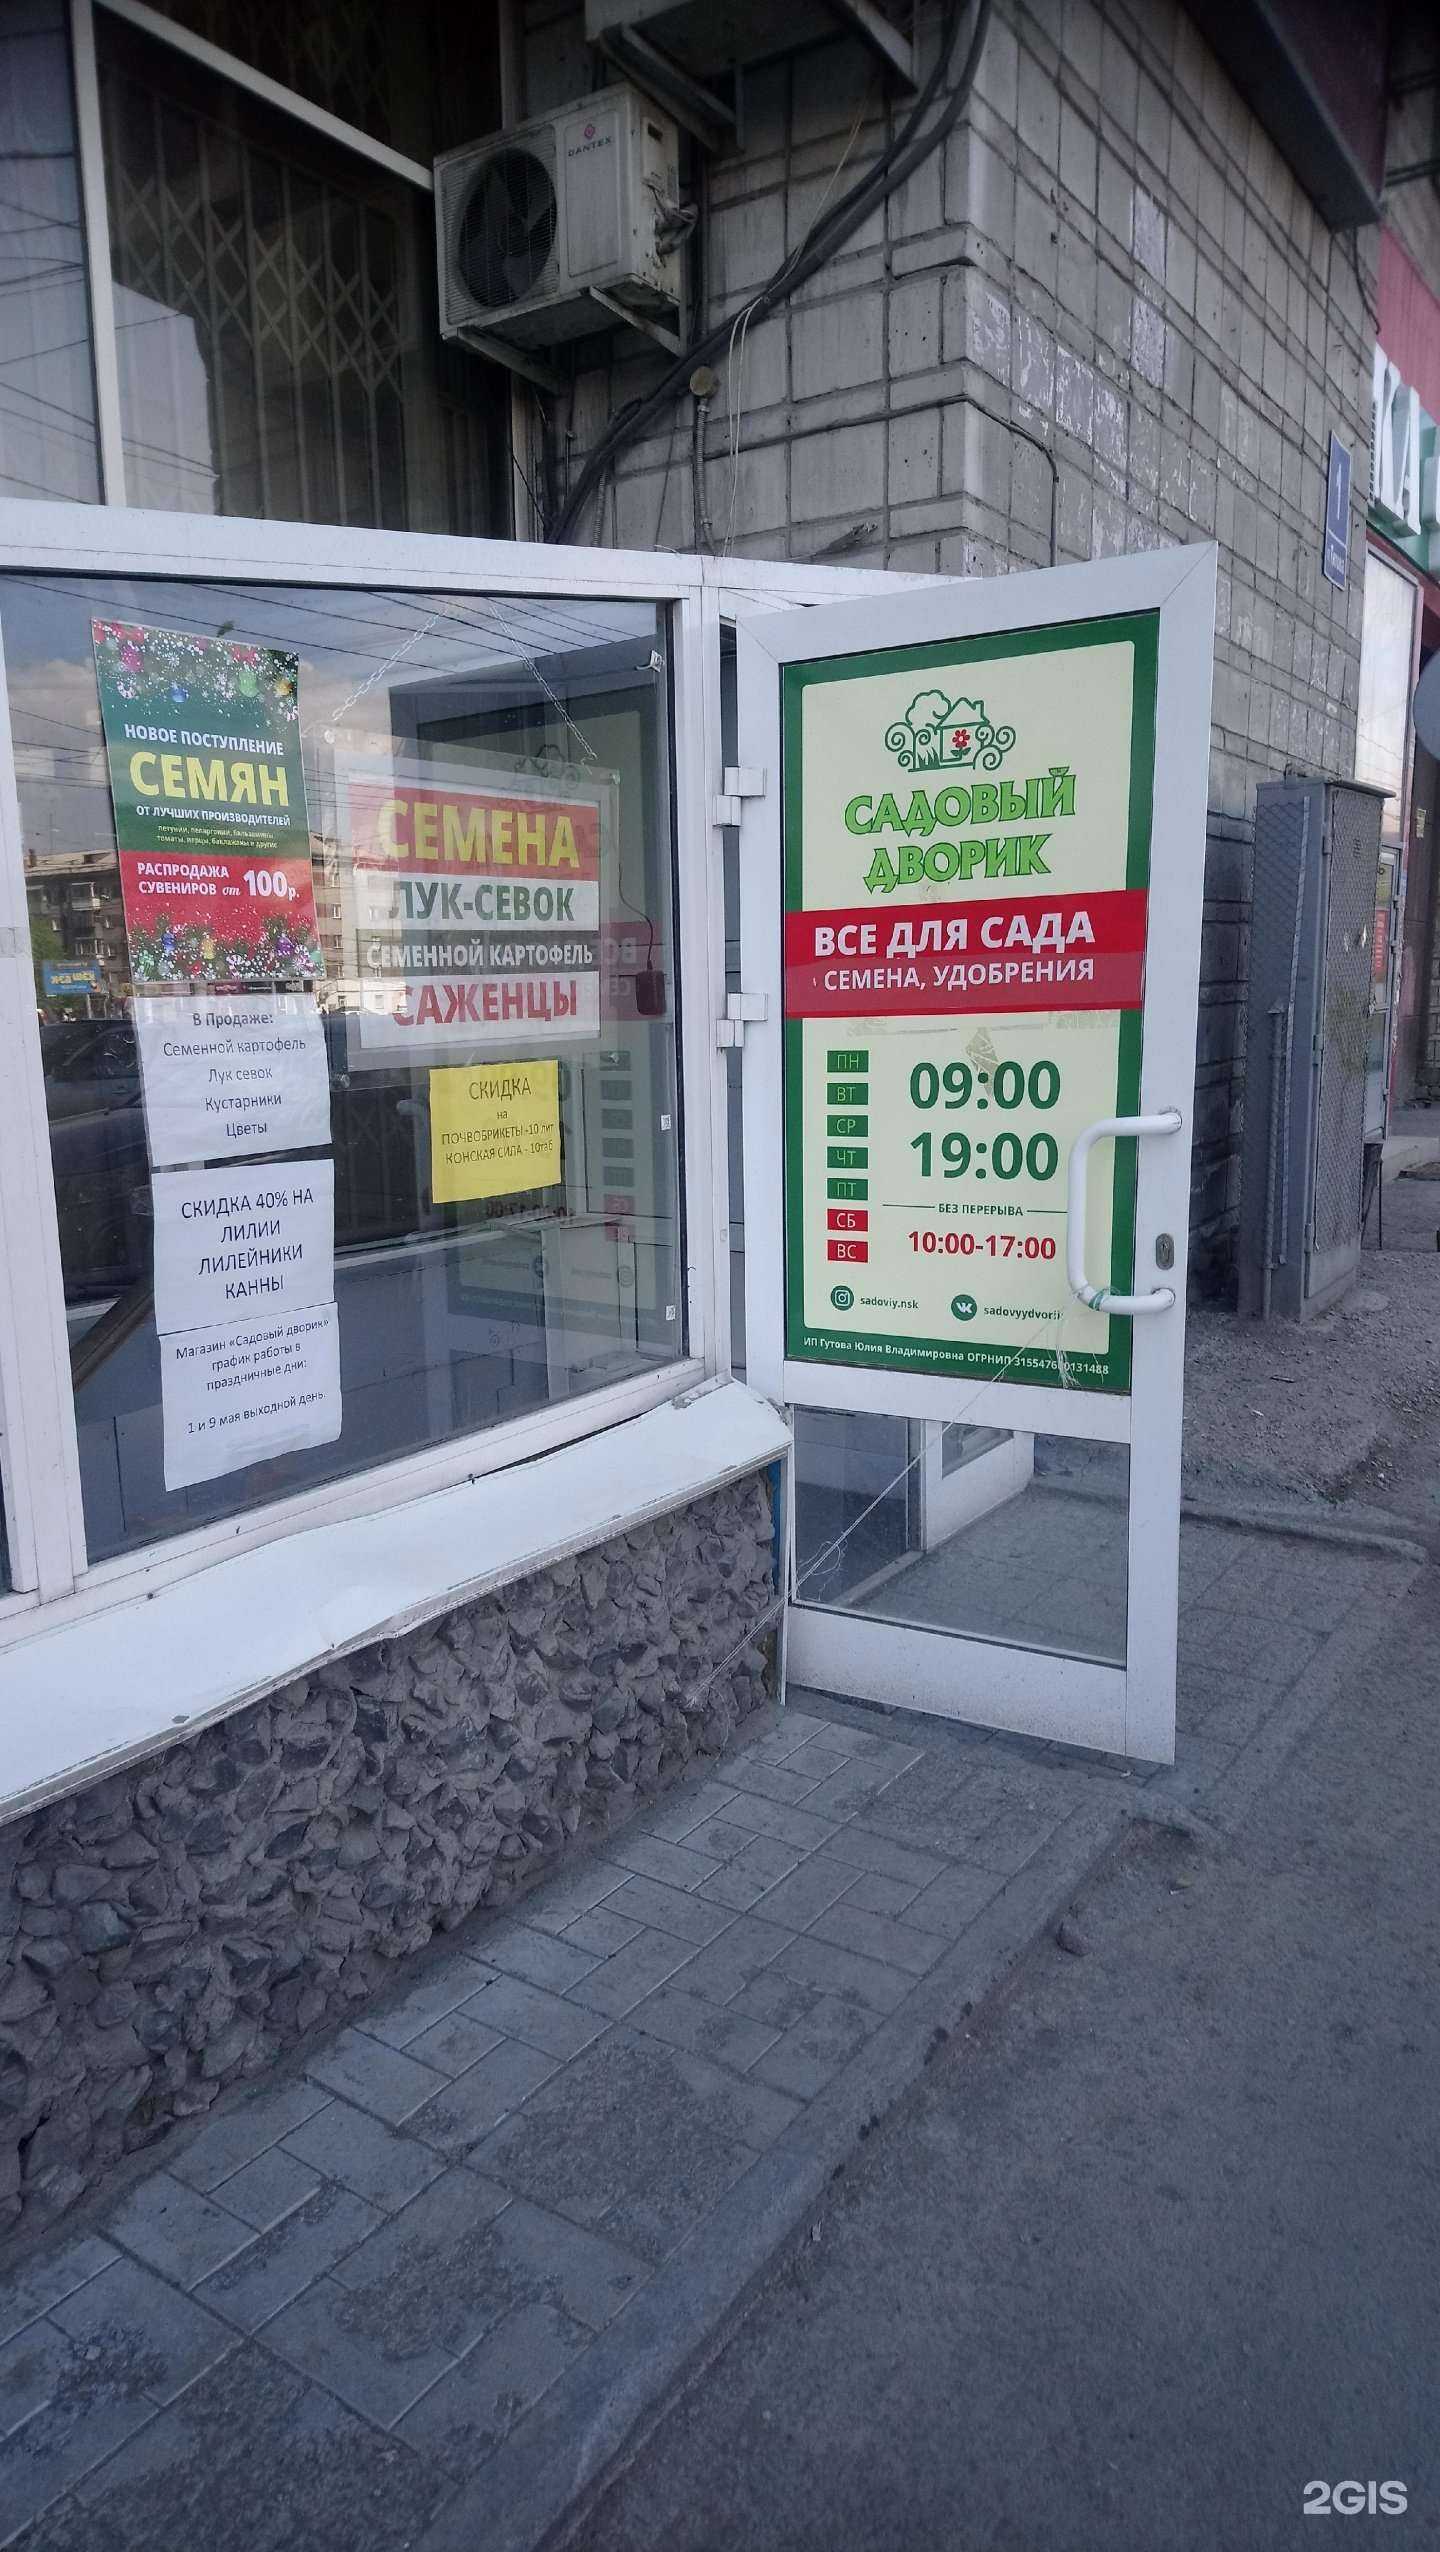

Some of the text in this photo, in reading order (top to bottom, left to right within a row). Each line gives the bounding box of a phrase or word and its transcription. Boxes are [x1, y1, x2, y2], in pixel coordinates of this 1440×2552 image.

[124, 723, 285, 756] НОВОЕ ПОСТУПЛЕНИЕ
[129, 751, 290, 807] СЕМЯН
[844, 766, 1077, 838] САДОВЫЙ
[136, 804, 291, 828] ОТ ЛУЧШИХ ПРОИЗВОДИТЕЛЕЙ
[378, 800, 581, 869] СЕМЕНА
[136, 862, 230, 880] РАСПРОДАЖА
[863, 833, 1054, 895] ДВОРИК
[138, 880, 217, 897] СУВЕНИРОВ
[222, 885, 241, 897] от
[389, 880, 576, 922] ЛУК-СЕВОК
[814, 911, 1096, 960] ВСЕ ДЛЯ САДА
[367, 937, 485, 968] СЕМЕННОЙ
[490, 943, 593, 967] КАРТОФЕЛЬ
[824, 959, 1095, 991] СЕМЕНА, УДОБРЕНИЯ
[392, 979, 578, 1027] САЖЕНЦЫ
[193, 1012, 274, 1027] В Продаже:
[163, 1036, 307, 1057] Семенной картофель
[837, 1054, 860, 1069] ПН
[208, 1068, 273, 1084] Лук севок
[909, 1060, 1062, 1110] 09:00
[469, 1078, 532, 1101] СКИДКА
[837, 1086, 856, 1101] ВТ
[205, 1094, 283, 1112] Кустарники
[496, 1110, 508, 1120] на
[226, 1122, 268, 1140] Цветы
[442, 1126, 523, 1145] ПОЧВОБРИКЕТЫ
[836, 1119, 857, 1134] СР
[445, 1147, 496, 1165] КОНСКАЯ
[497, 1145, 522, 1159] СИЛА
[837, 1151, 856, 1166] ЧТ
[910, 1131, 1059, 1181] 19:00
[837, 1182, 856, 1197] ПТ
[181, 1188, 314, 1219] СКИДКА 40% НА
[938, 1202, 1024, 1218] БЕЗ ПЕРЕРЫВА
[221, 1219, 281, 1243] ЛИЛИИ
[836, 1213, 857, 1228] СБ
[837, 1244, 857, 1260] ВС
[908, 1230, 1057, 1261] 10:00-17:00
[198, 1244, 303, 1276] ЛИЛЕЙНИКИ
[225, 1275, 285, 1300] КАННЫ
[860, 1295, 919, 1311] sadoviy.nsk
[176, 1318, 329, 1360] Магазин «Садовый дворик»
[212, 1354, 251, 1373] график
[254, 1346, 293, 1367] работы
[803, 1337, 1109, 1375] ИП Гутова Юлия Владимировна ОГРНИП 31554760131488
[207, 1359, 307, 1392] праздничные дни:
[198, 1421, 206, 1432] и
[209, 1416, 216, 1429] 9
[219, 1413, 241, 1427] мая
[244, 1394, 297, 1420] выходной
[299, 1390, 326, 1406] день.
